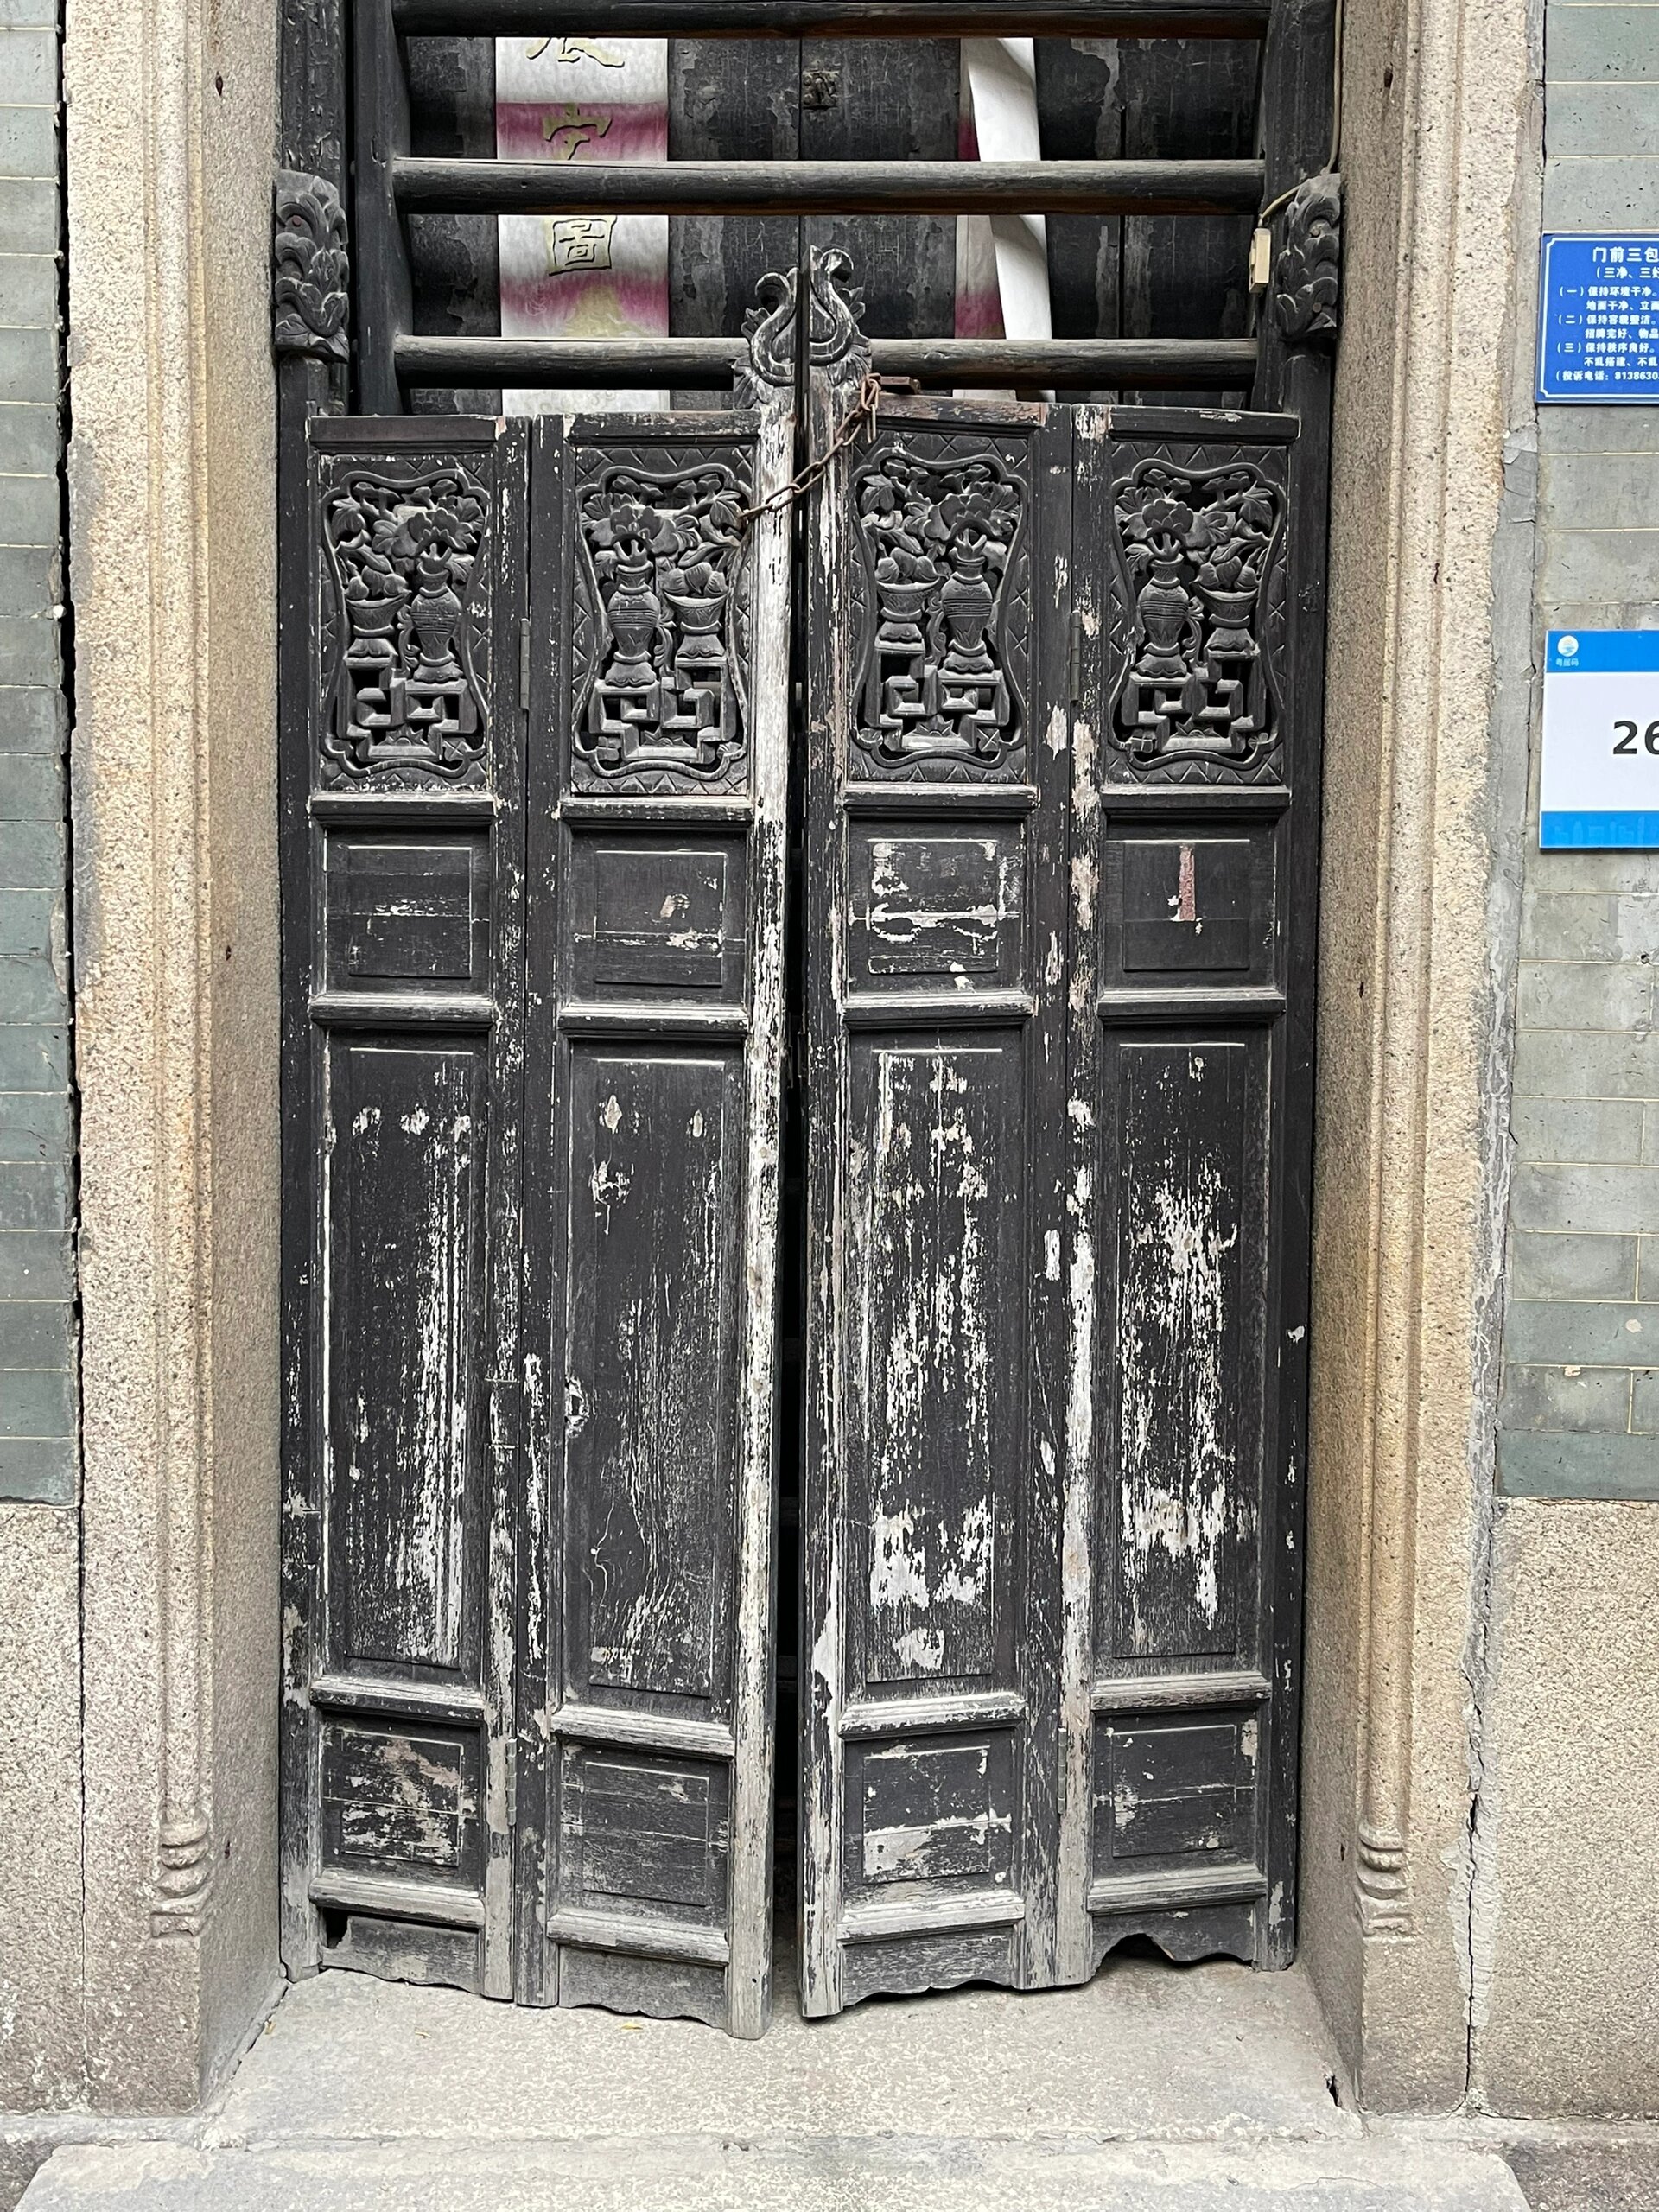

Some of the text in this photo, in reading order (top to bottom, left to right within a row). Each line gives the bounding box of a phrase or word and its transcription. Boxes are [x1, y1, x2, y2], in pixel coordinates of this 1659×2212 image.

[1592, 246, 1659, 263] 门前三包
[1612, 720, 1659, 755] 26
